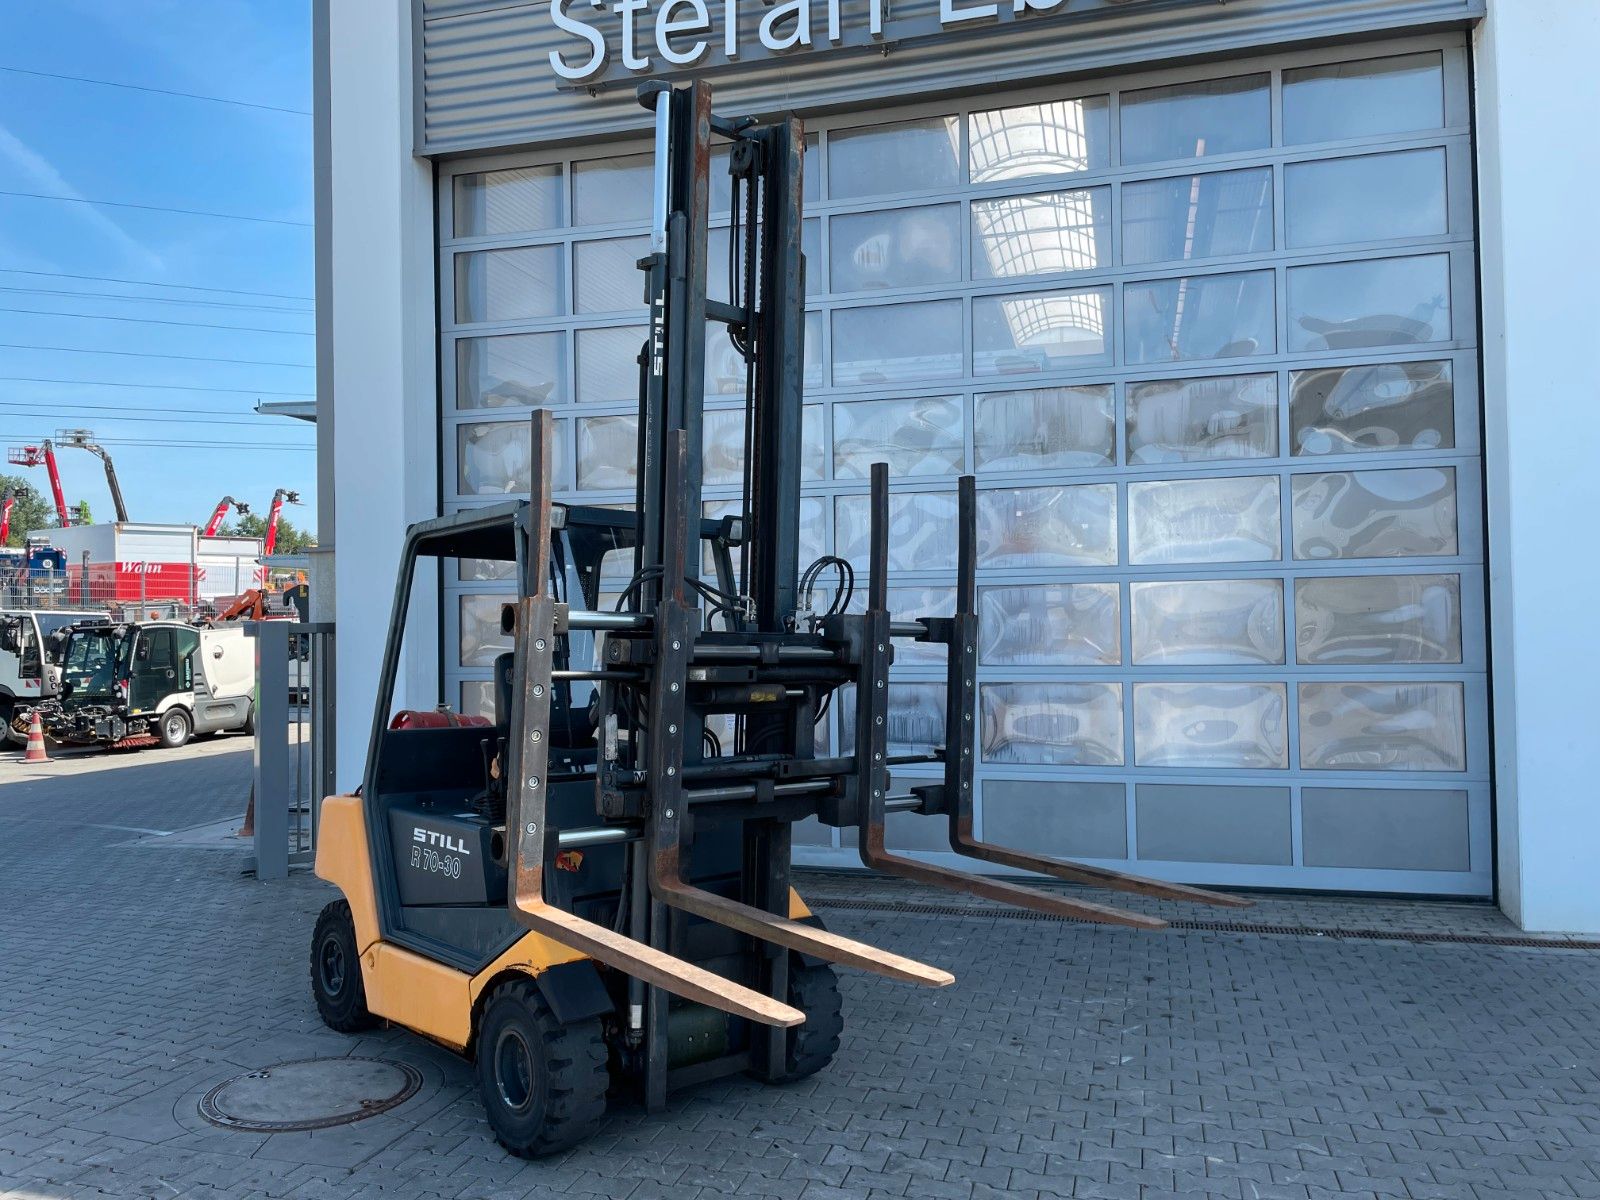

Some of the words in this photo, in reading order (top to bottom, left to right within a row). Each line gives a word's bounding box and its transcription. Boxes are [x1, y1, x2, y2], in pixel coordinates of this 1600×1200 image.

[654, 289, 665, 376] STILL
[121, 561, 162, 574] Wohn
[413, 827, 470, 855] STILL
[411, 845, 420, 868] R
[423, 848, 461, 879] 70-30
